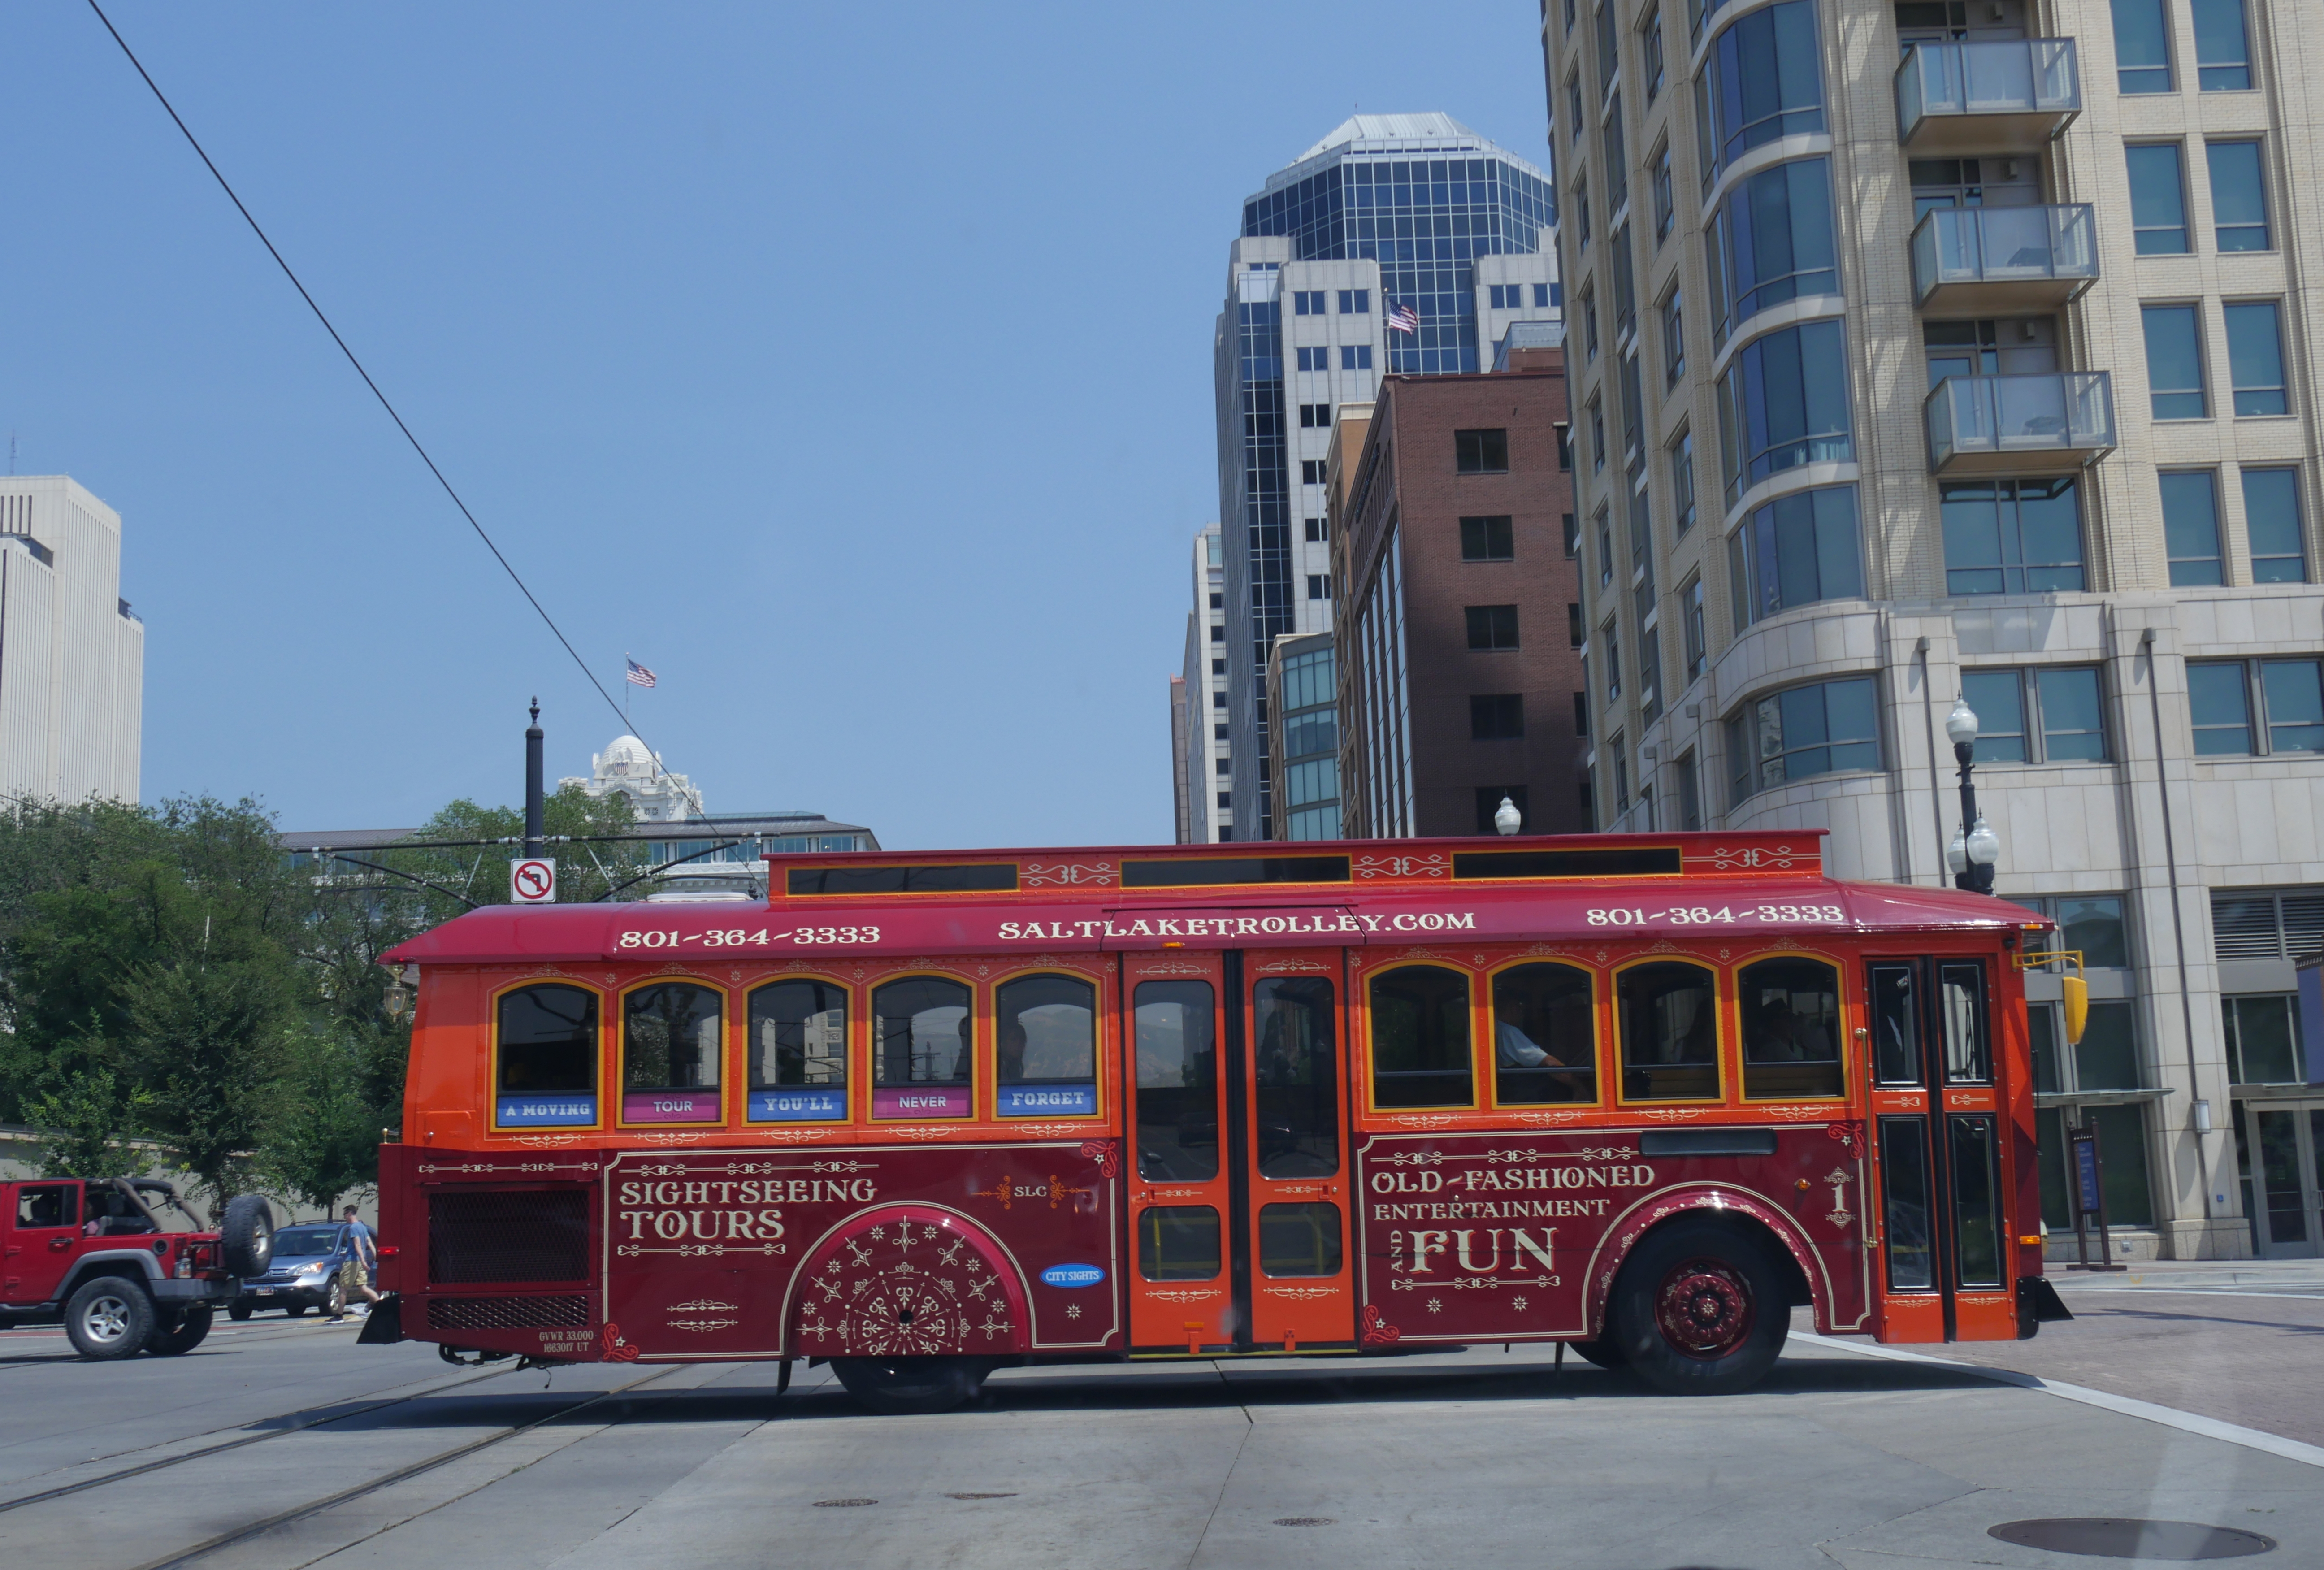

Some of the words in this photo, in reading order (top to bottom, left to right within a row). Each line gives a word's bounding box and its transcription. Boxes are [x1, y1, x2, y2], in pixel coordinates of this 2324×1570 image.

[997, 913, 1476, 940] SALTLAKETROLLEY.COM
[765, 1097, 833, 1111] YOU'LL
[898, 1096, 947, 1108] NEVER
[1011, 1092, 1084, 1106] FORGET
[506, 1105, 516, 1116] A
[522, 1104, 590, 1116] MOVING
[653, 1101, 693, 1112] TOUR
[619, 1178, 878, 1205] SIGHTSEEING
[1014, 1186, 1047, 1197] SLC
[1831, 1184, 1849, 1212] 1
[1373, 1198, 1611, 1221] ENTERTAINMENT
[619, 1209, 785, 1240] TOURS
[1390, 1229, 1404, 1274] AND
[1408, 1227, 1560, 1274] FUN
[1045, 1271, 1067, 1281] CITY
[1067, 1271, 1100, 1281] SIGHTS
[539, 1331, 563, 1341] GVWR
[577, 1342, 589, 1351] UT
